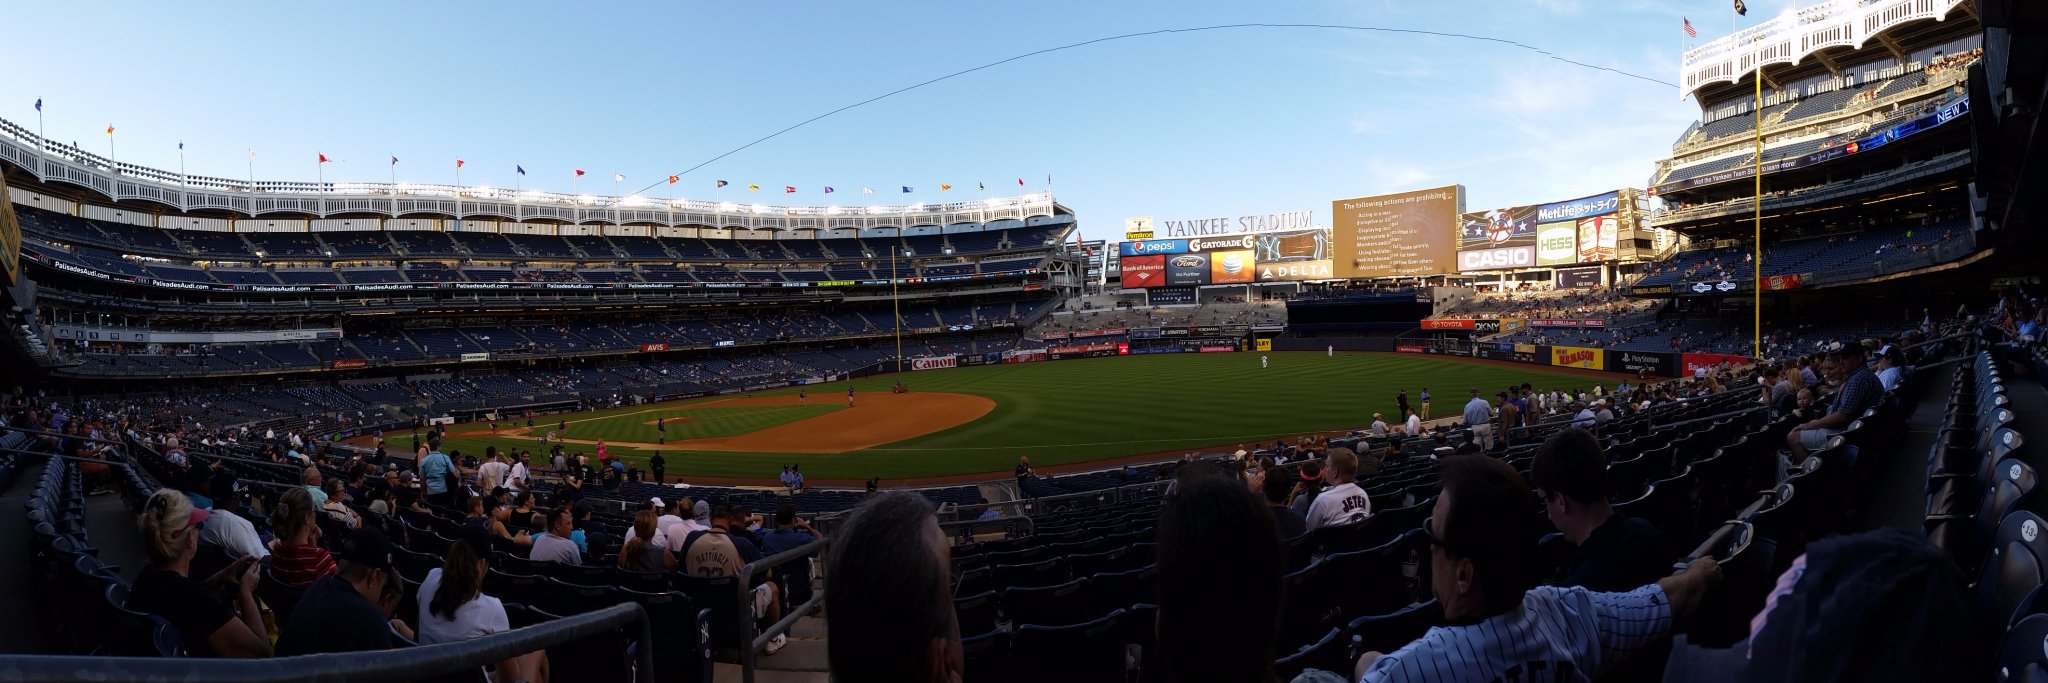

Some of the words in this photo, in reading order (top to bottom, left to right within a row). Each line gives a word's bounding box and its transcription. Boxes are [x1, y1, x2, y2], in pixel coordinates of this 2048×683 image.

[1937, 104, 1960, 123] NEW
[1712, 173, 1732, 182] Yankees
[1733, 170, 1746, 178] Team
[1356, 201, 1383, 209] following
[1383, 198, 1405, 206] actions
[1577, 197, 1618, 215] メットライフ
[1538, 205, 1575, 221] MetLife
[1164, 217, 1229, 237] YANKEE
[1238, 210, 1313, 232] STADIUM
[1147, 241, 1175, 252] pepsi
[1201, 239, 1242, 249] GATORADE
[1541, 236, 1573, 252] HESS
[1177, 256, 1199, 267] Ford
[1464, 248, 1529, 268] CASIO
[55, 260, 110, 280] PalisadesAudi.com
[1278, 264, 1329, 277] DELTA
[152, 279, 209, 290] PalisadesAudi.com
[1475, 322, 1500, 331] DKNY
[1506, 322, 1517, 331] SAP
[912, 356, 956, 369] Canon
[1632, 354, 1660, 364] PlayStation
[1342, 495, 1367, 513] JETER
[2025, 525, 2034, 537] 13
[696, 552, 729, 566] MATTINGLY
